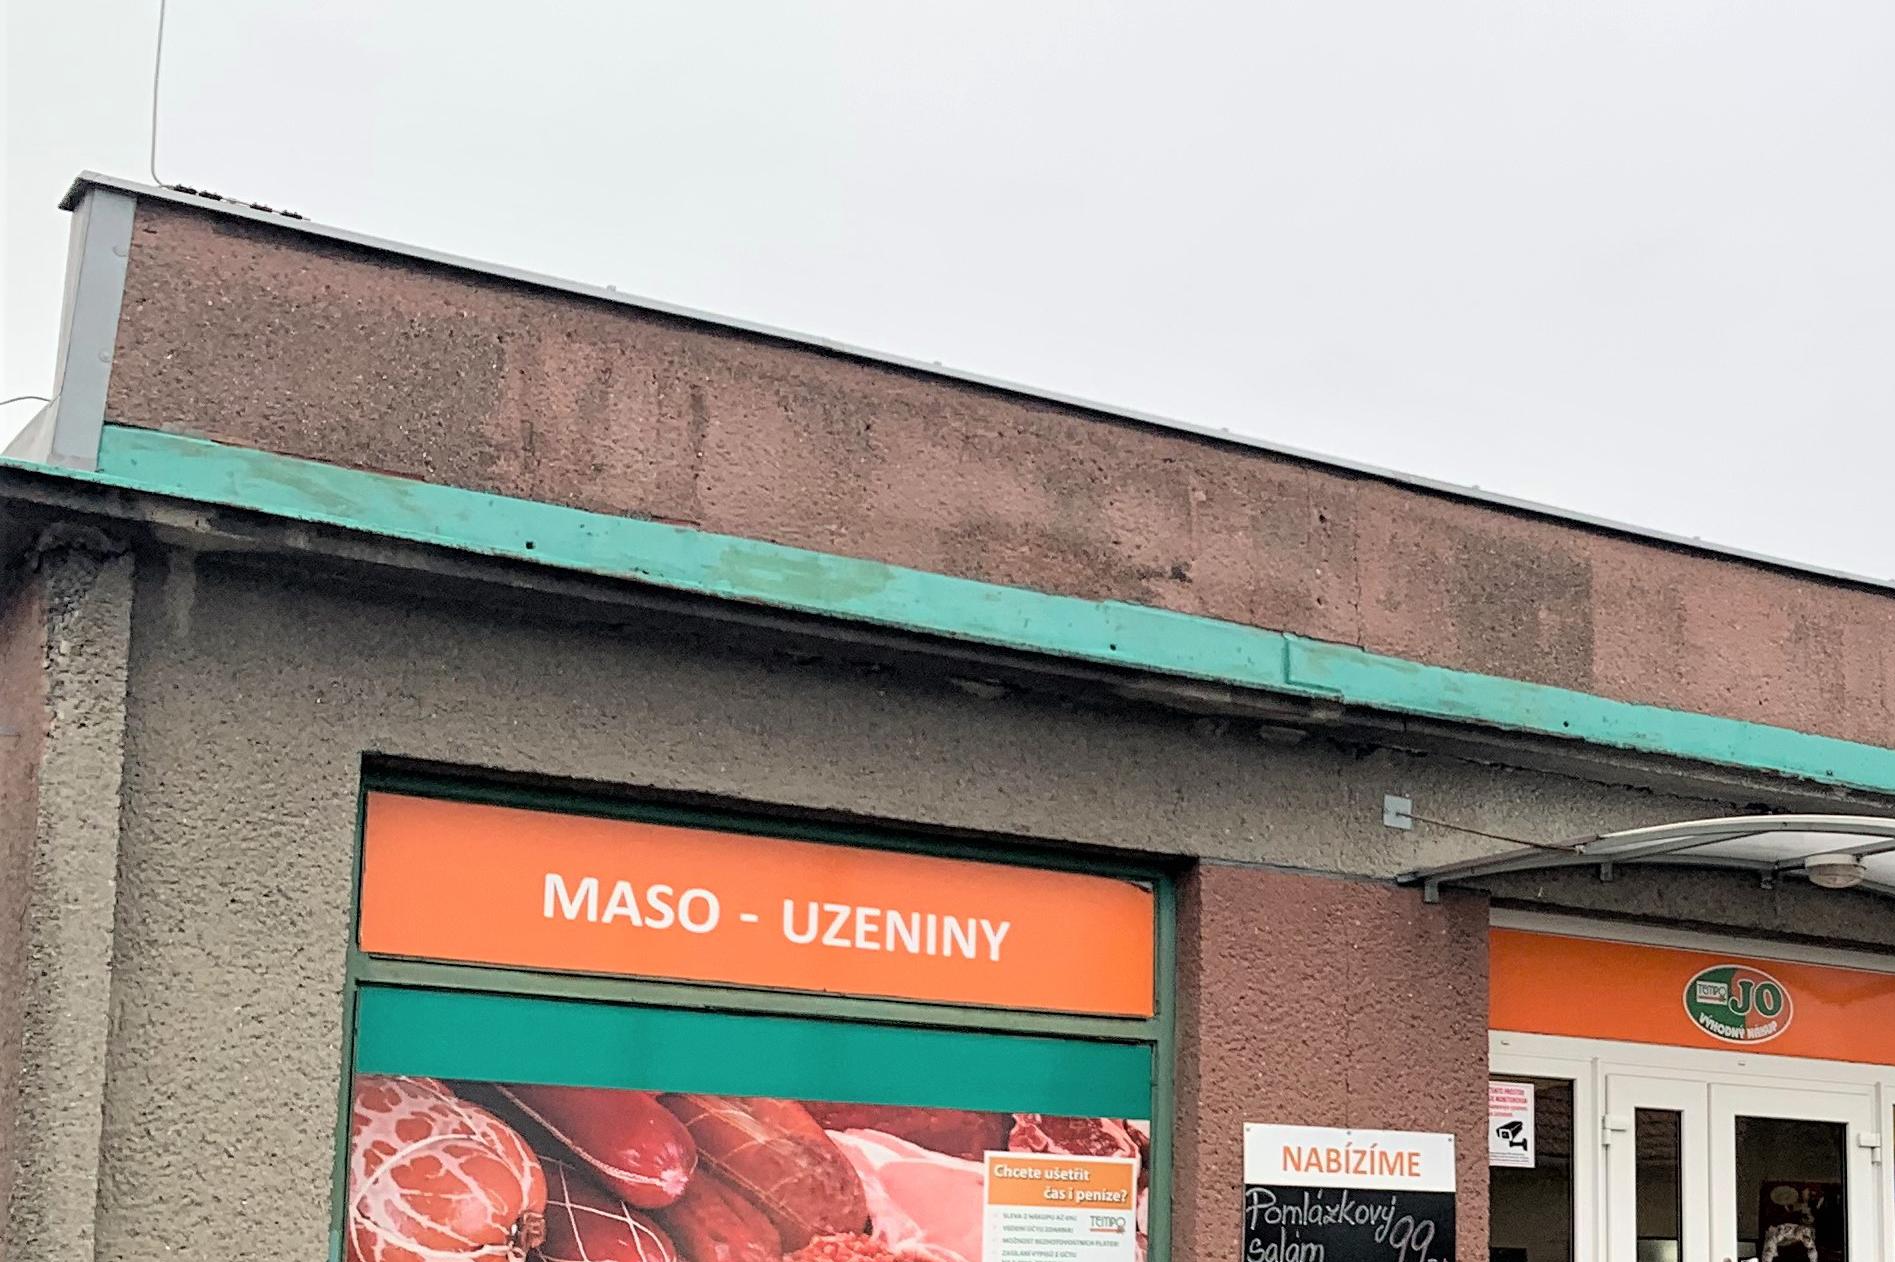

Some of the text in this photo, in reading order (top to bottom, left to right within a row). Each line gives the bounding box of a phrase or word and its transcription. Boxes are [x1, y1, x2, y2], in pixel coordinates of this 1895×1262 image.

[543, 872, 1011, 962] MASO - UZENINY
[1728, 978, 1783, 1018] JO
[1699, 1011, 1745, 1039] VÝHODNÝ
[994, 1165, 1090, 1182] Chcete ušetřit
[1282, 1141, 1422, 1177] NABÍZÍME
[1043, 1186, 1066, 1200] čas
[1076, 1188, 1128, 1203] peníze?
[1090, 1215, 1126, 1229] TEMPO
[1245, 1186, 1396, 1244] Pomlázkový
